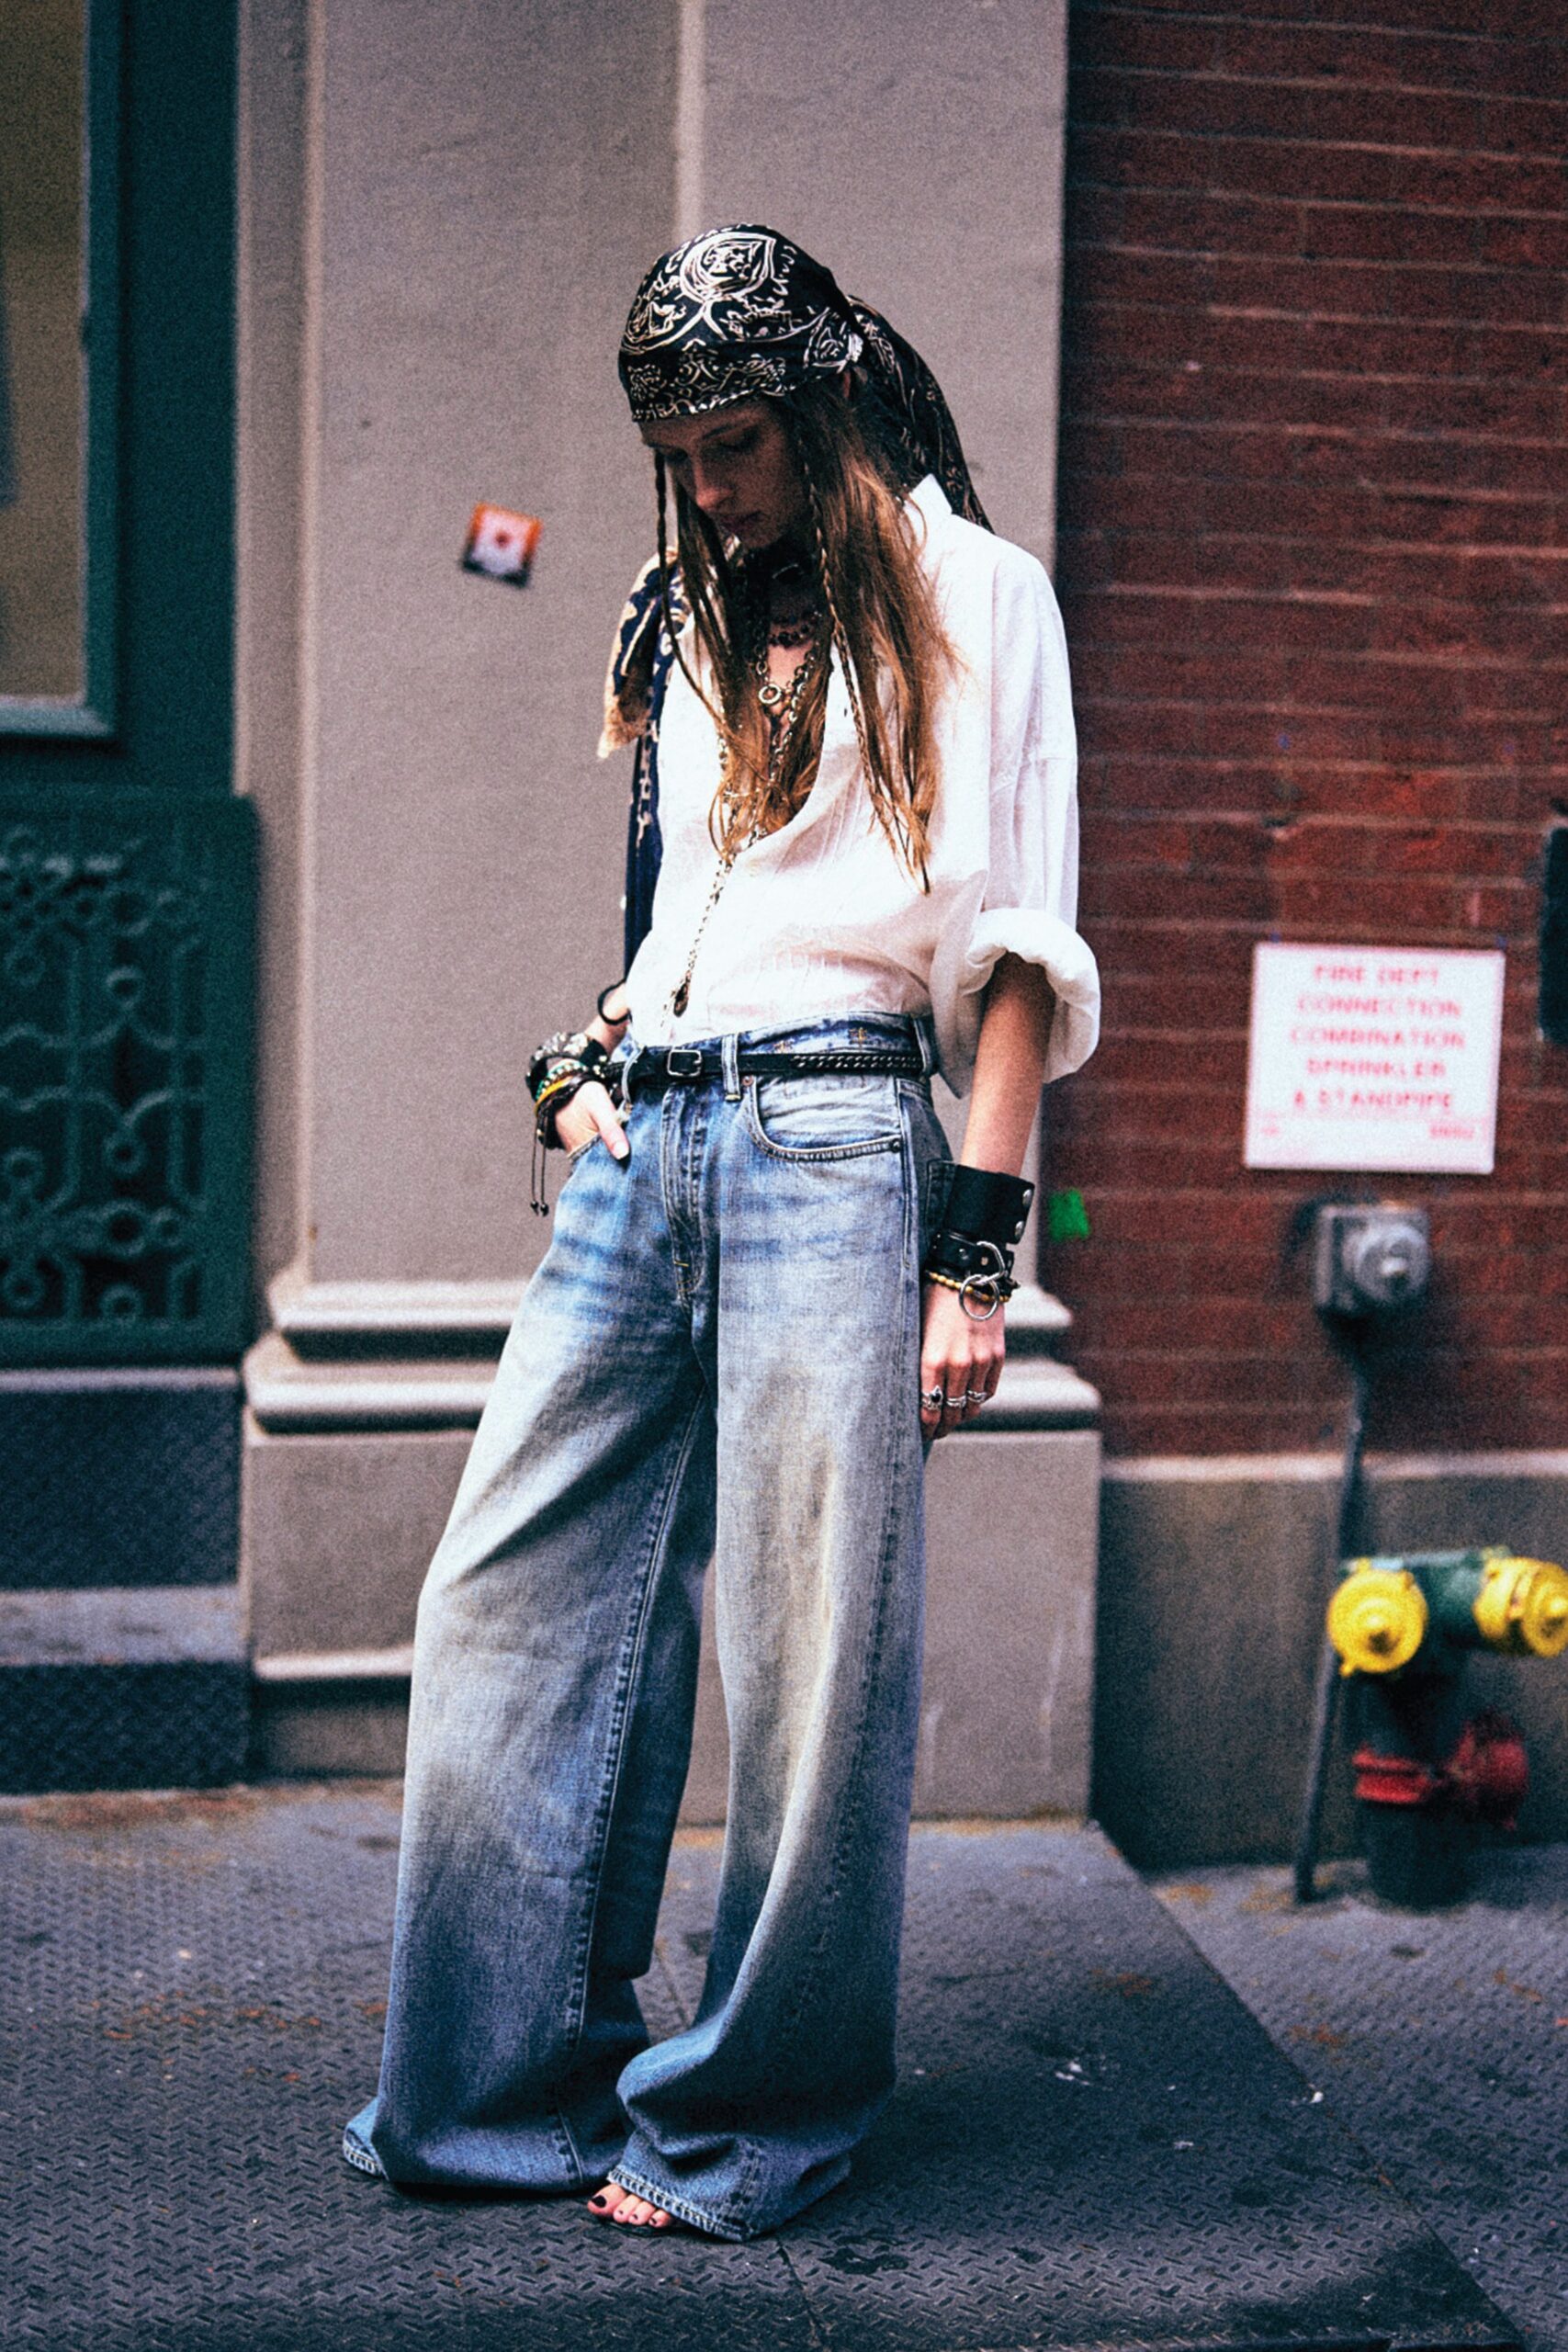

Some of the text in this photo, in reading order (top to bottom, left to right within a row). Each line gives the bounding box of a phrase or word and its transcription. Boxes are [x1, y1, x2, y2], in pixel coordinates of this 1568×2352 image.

[1298, 994, 1461, 1016] CONNECTION
[1291, 1026, 1466, 1048] COMBINATION
[1307, 1057, 1447, 1077] SPRINKLER
[1318, 1090, 1451, 1110] STANDPIPE
